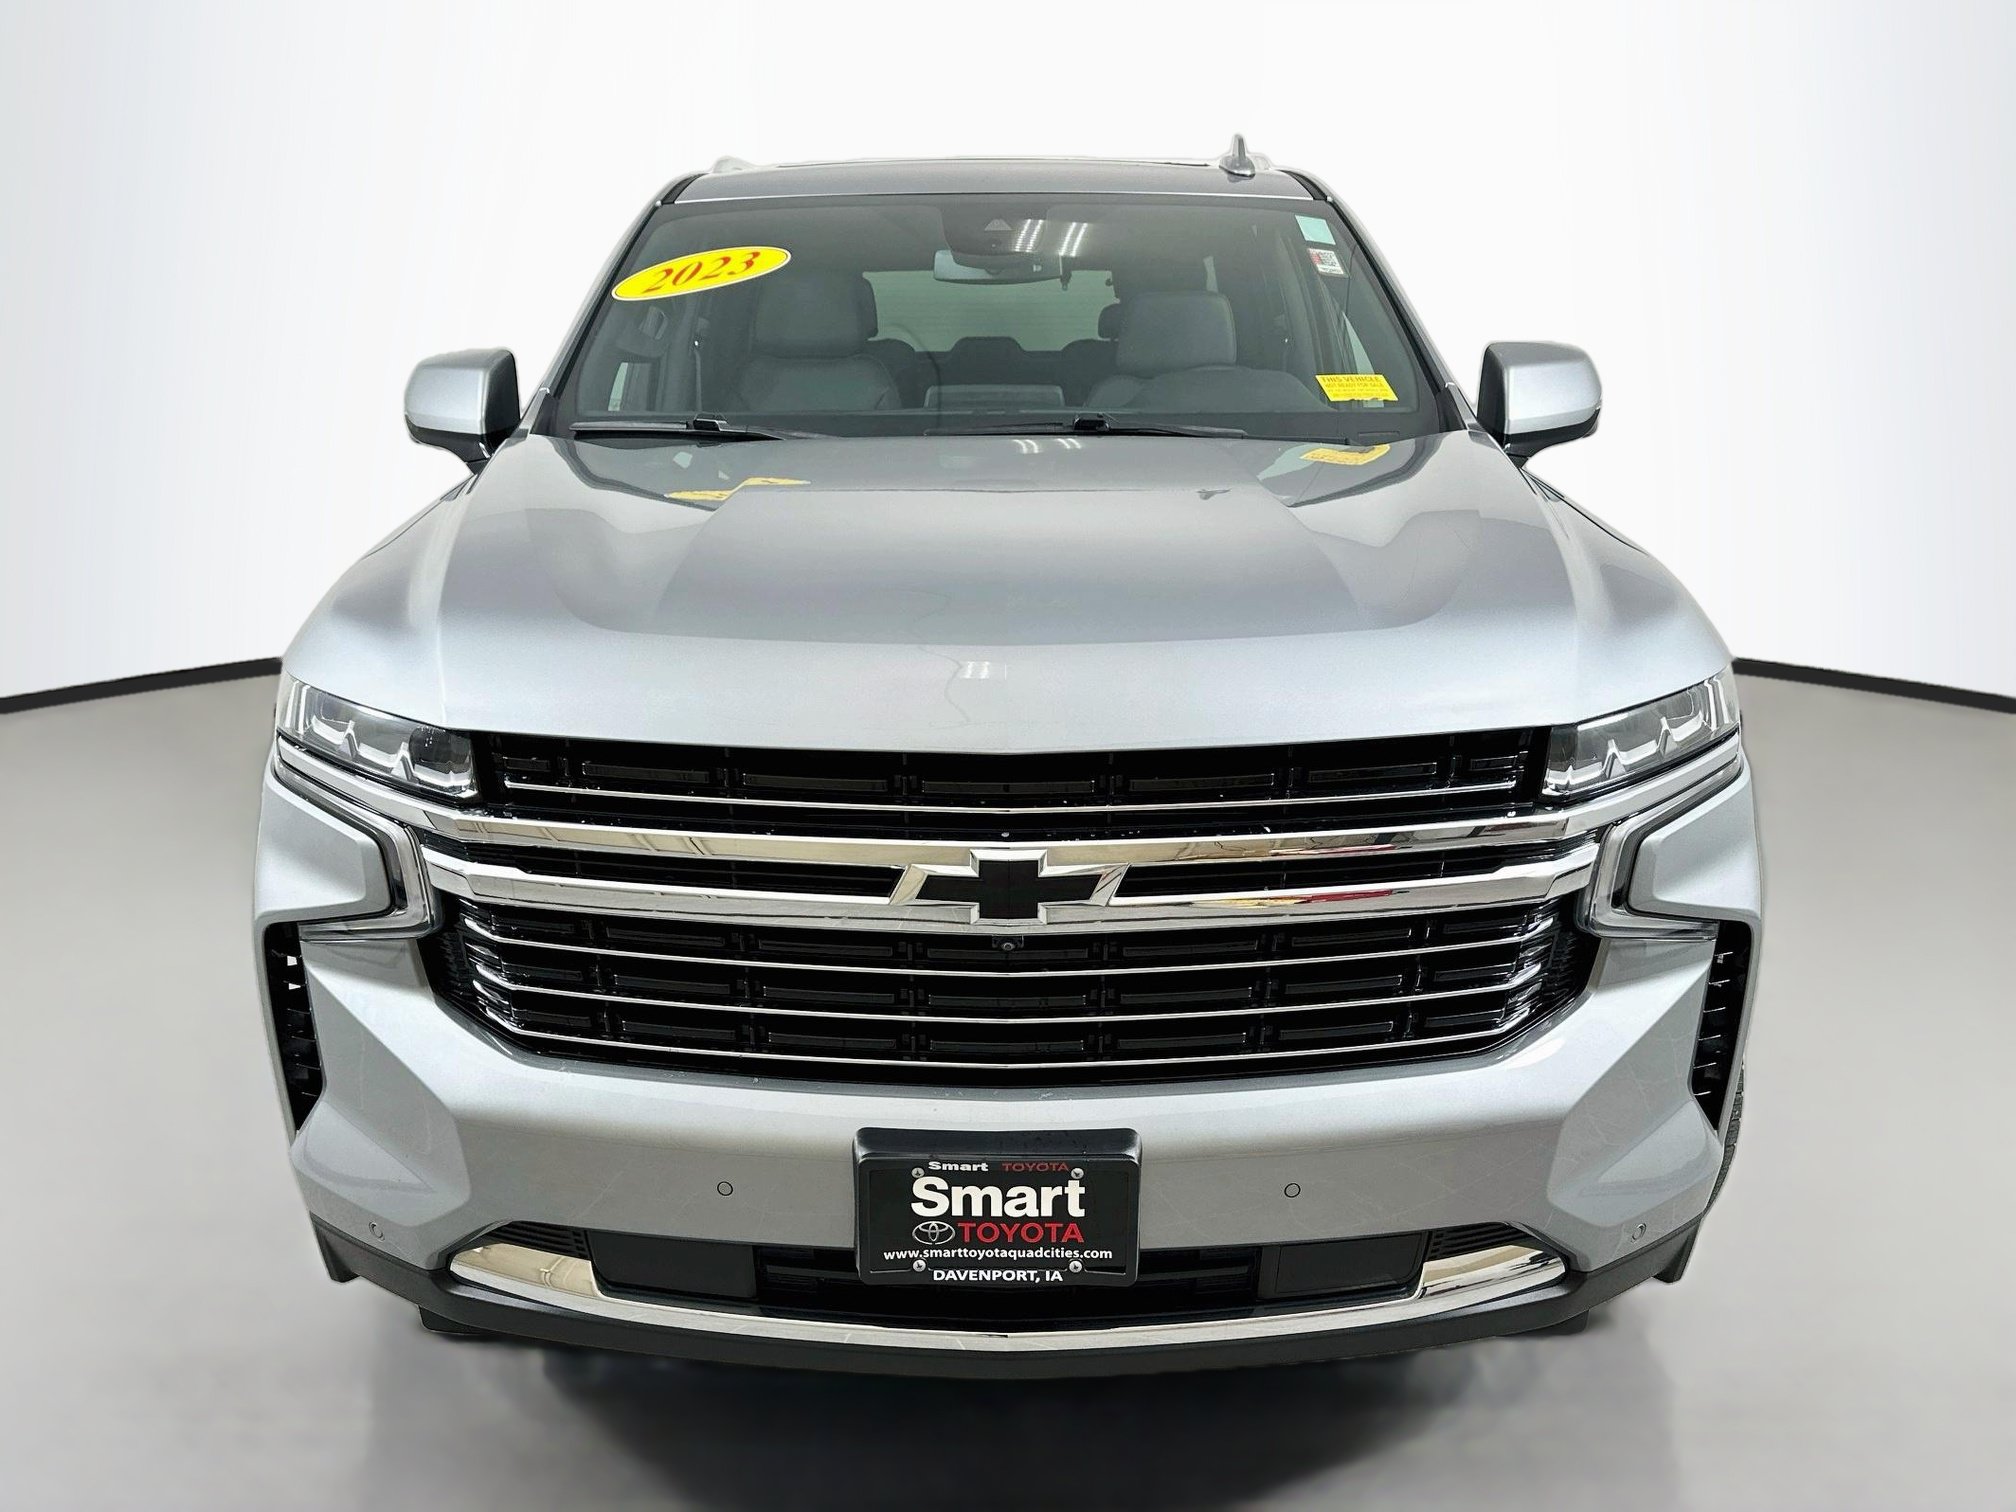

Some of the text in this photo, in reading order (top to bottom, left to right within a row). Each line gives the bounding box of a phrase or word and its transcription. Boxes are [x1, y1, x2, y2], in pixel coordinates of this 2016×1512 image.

[642, 251, 761, 294] 2023
[928, 1160, 1070, 1172] Smart TOYOTA
[911, 1176, 1086, 1218] Smart
[956, 1221, 1084, 1244] TOYOTA
[883, 1247, 1113, 1261] www.smarttoyotaquadcities.com
[932, 1269, 1063, 1283] DAVENPORT, IA
